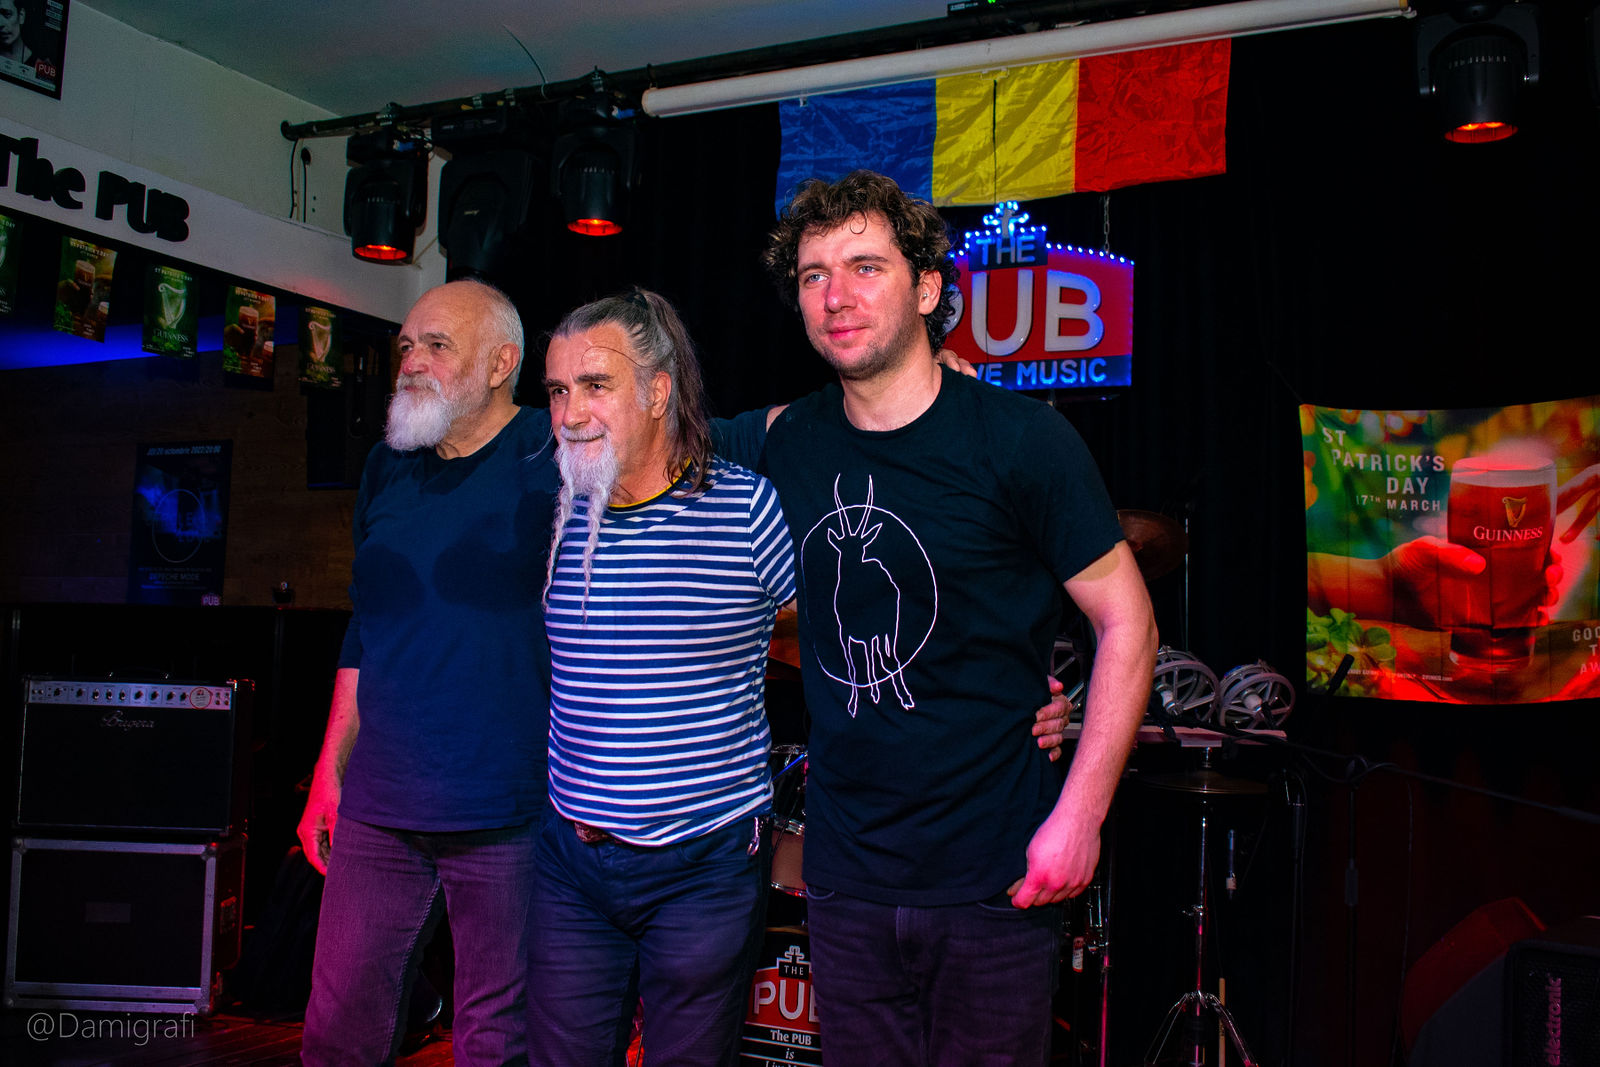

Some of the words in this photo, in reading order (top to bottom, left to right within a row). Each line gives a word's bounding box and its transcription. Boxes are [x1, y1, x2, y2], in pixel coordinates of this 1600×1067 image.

[38, 63, 56, 77] PUB
[0, 134, 87, 210] The
[95, 170, 190, 243] PUB
[975, 234, 1036, 266] THE
[1016, 357, 1108, 386] MUSIC
[1322, 427, 1347, 446] ST
[1331, 448, 1446, 473] PATRICK'S
[1386, 477, 1430, 495] DAY
[1386, 498, 1442, 512] MARCH
[1472, 525, 1544, 542] GUINNESS
[202, 595, 220, 606] PUB
[784, 964, 804, 976] THE
[770, 1028, 790, 1043] The
[791, 1032, 812, 1046] PUB
[785, 1047, 795, 1060] is
